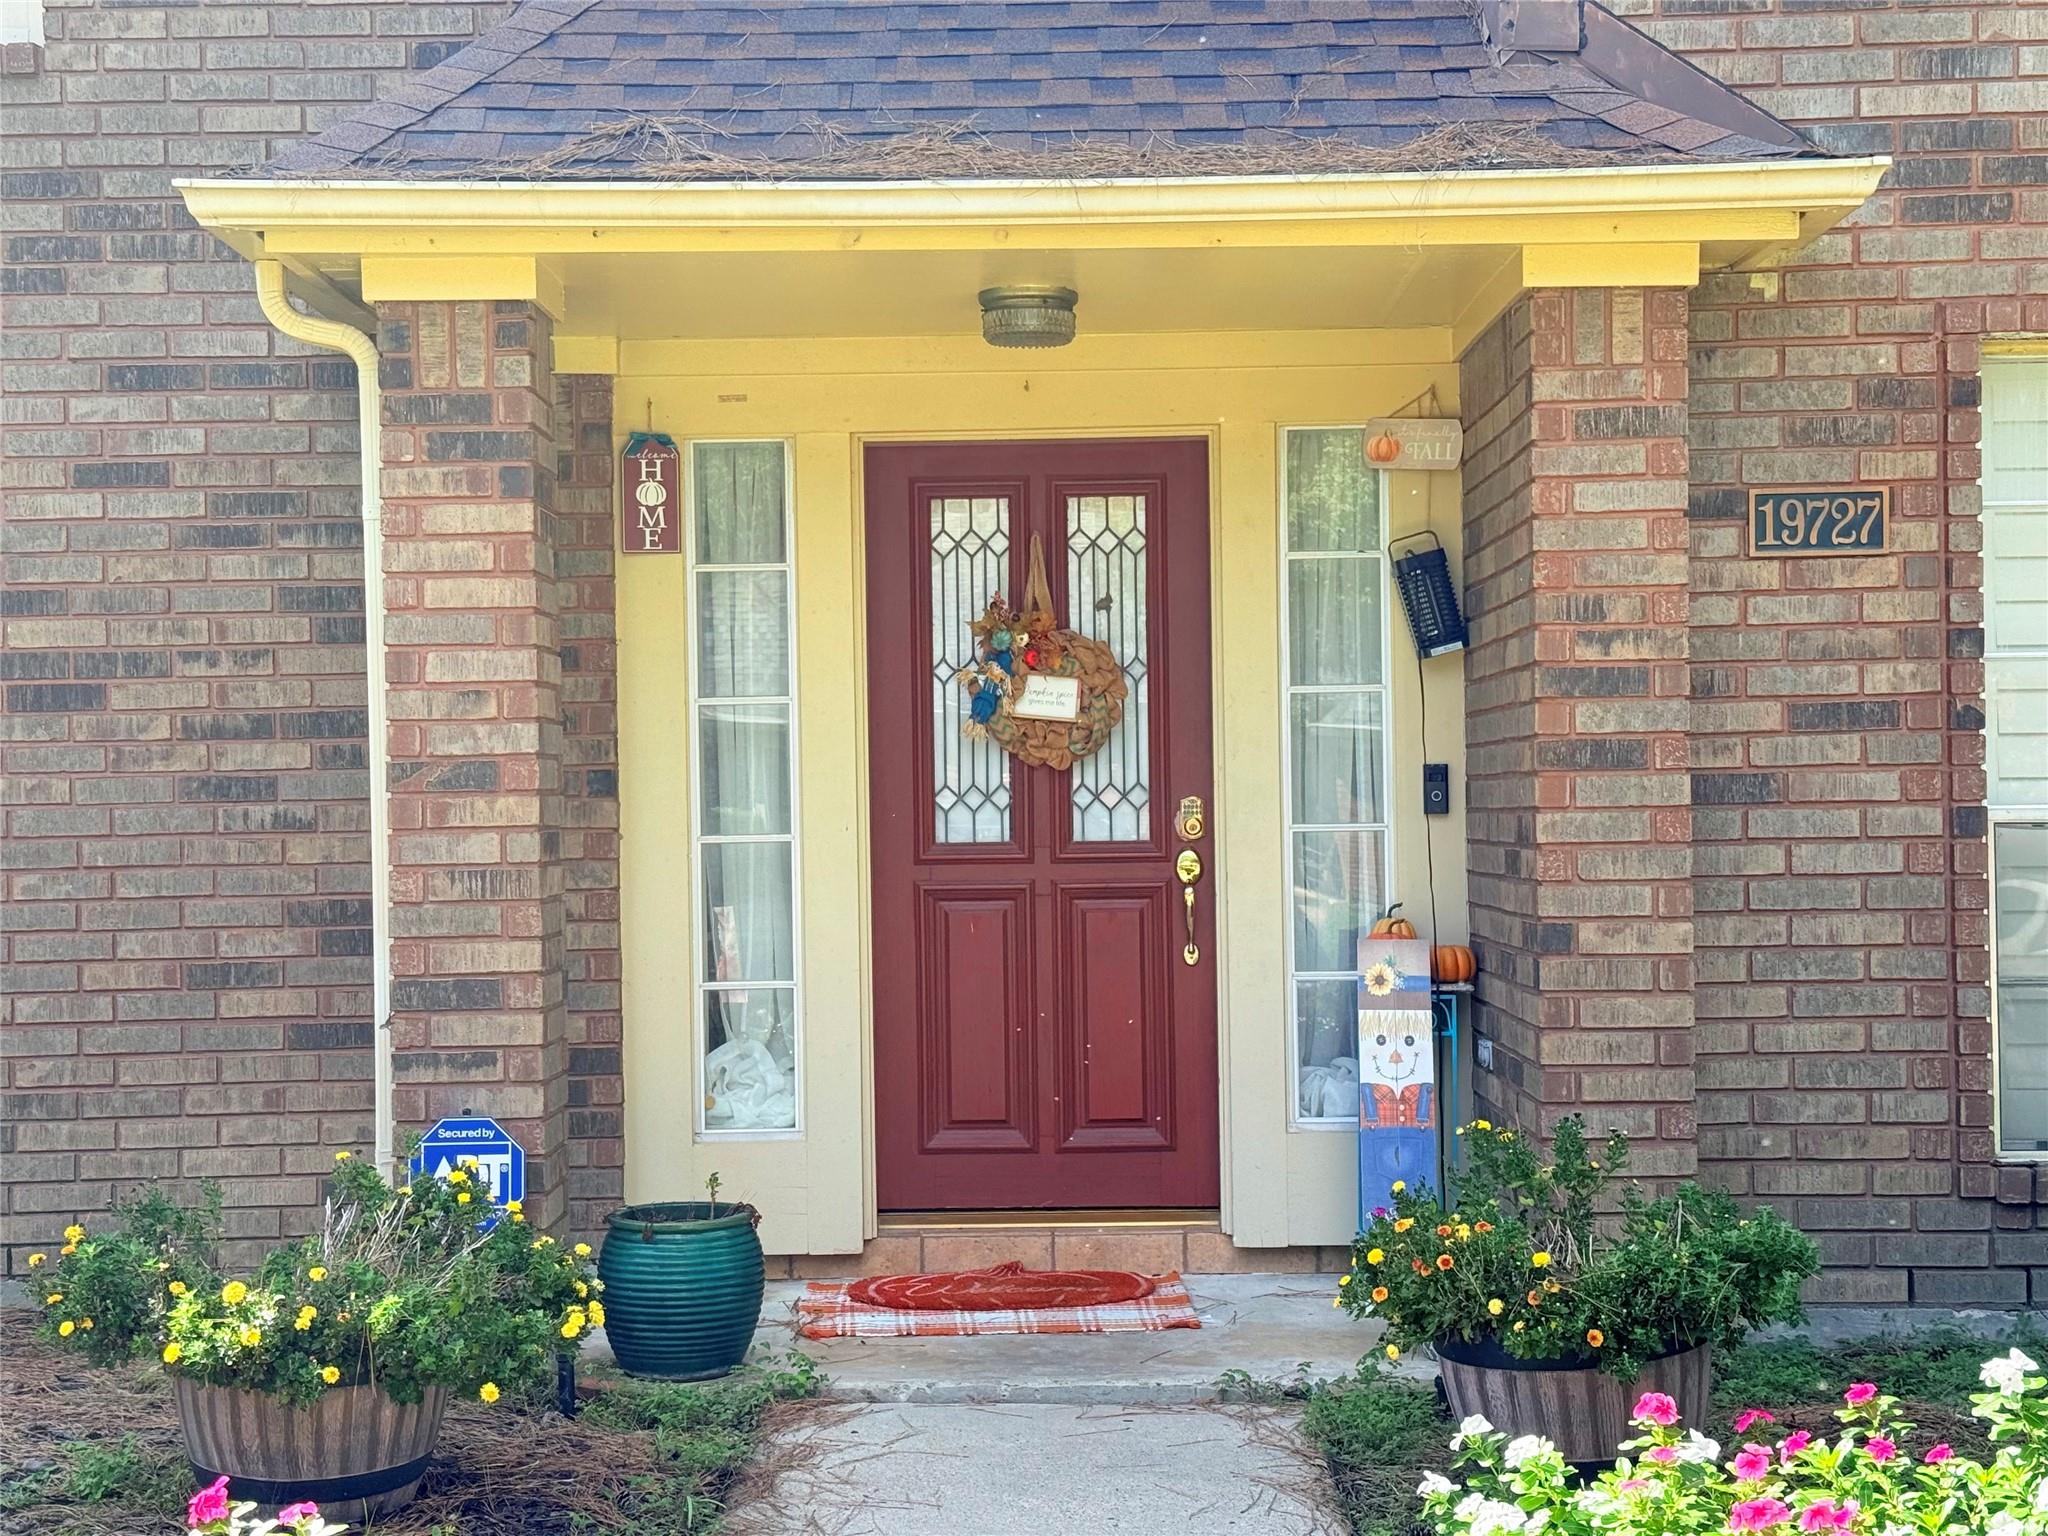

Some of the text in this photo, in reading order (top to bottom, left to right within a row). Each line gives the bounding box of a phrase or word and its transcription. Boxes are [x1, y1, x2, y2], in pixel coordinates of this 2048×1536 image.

[626, 448, 676, 459] elcome
[1405, 442, 1456, 460] FALL
[1758, 498, 1880, 545] 19727
[438, 1128, 495, 1139] Secured by
